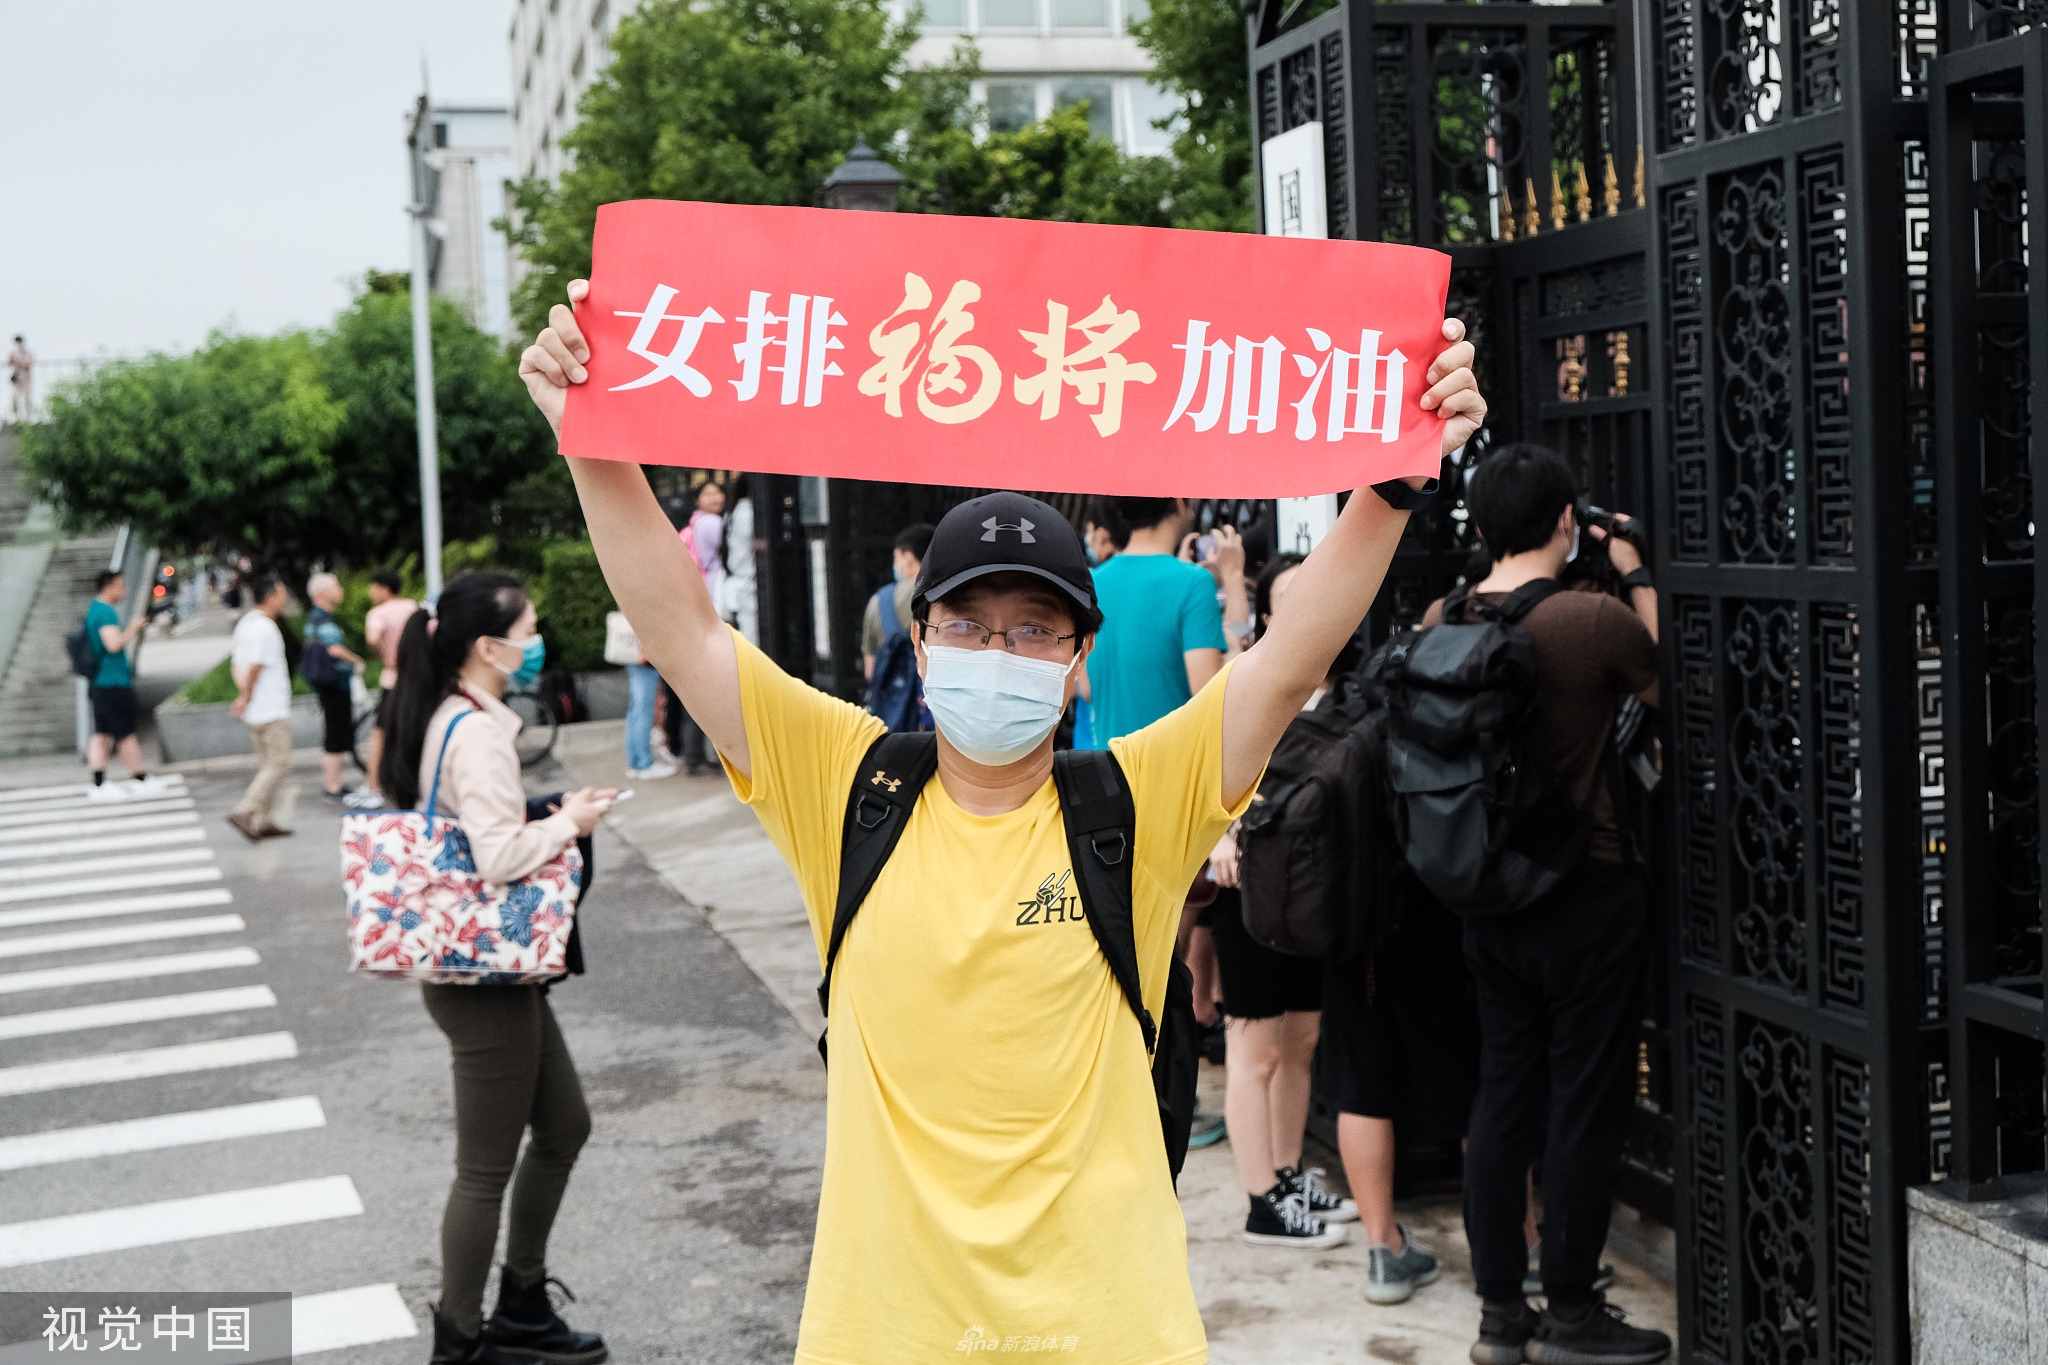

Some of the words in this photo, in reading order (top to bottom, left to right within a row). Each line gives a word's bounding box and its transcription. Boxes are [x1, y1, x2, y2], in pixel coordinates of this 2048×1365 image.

[607, 271, 1408, 443] 女排福将加油
